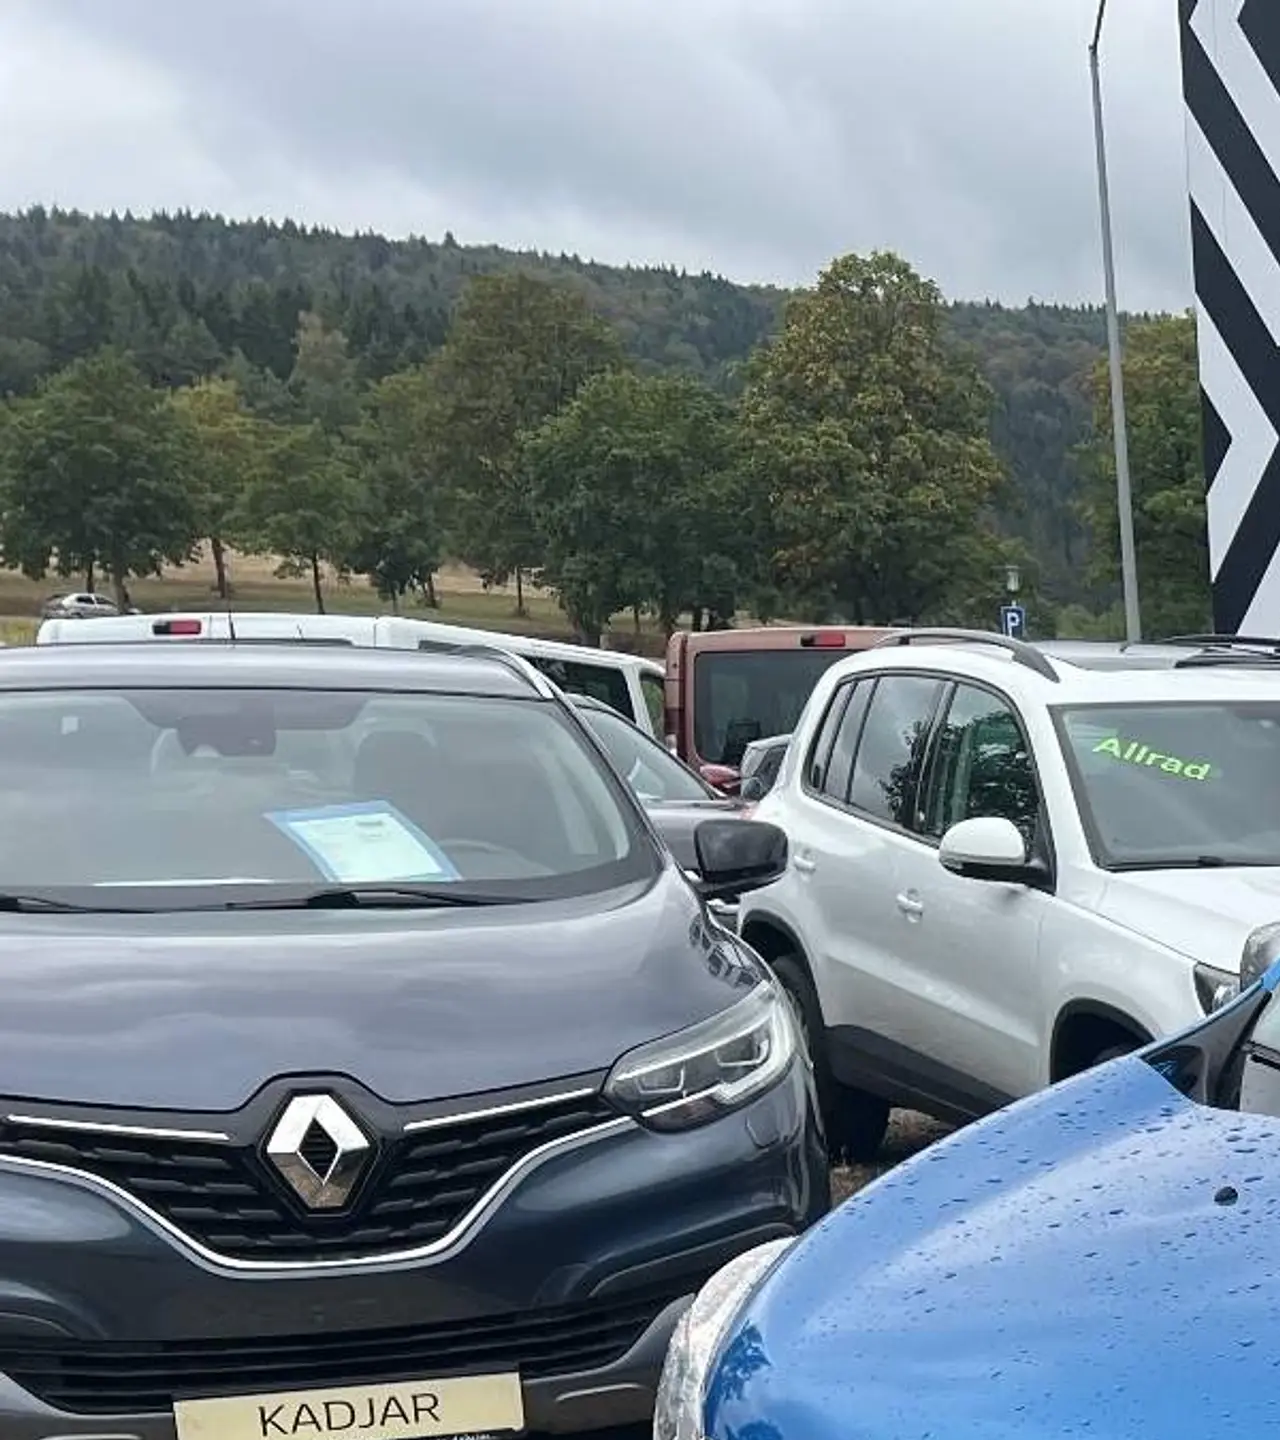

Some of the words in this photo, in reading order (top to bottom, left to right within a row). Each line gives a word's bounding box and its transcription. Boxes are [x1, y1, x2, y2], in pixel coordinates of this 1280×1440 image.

[1006, 612, 1020, 638] P
[1091, 737, 1211, 780] Allrad
[258, 1392, 441, 1437] KADJAR
